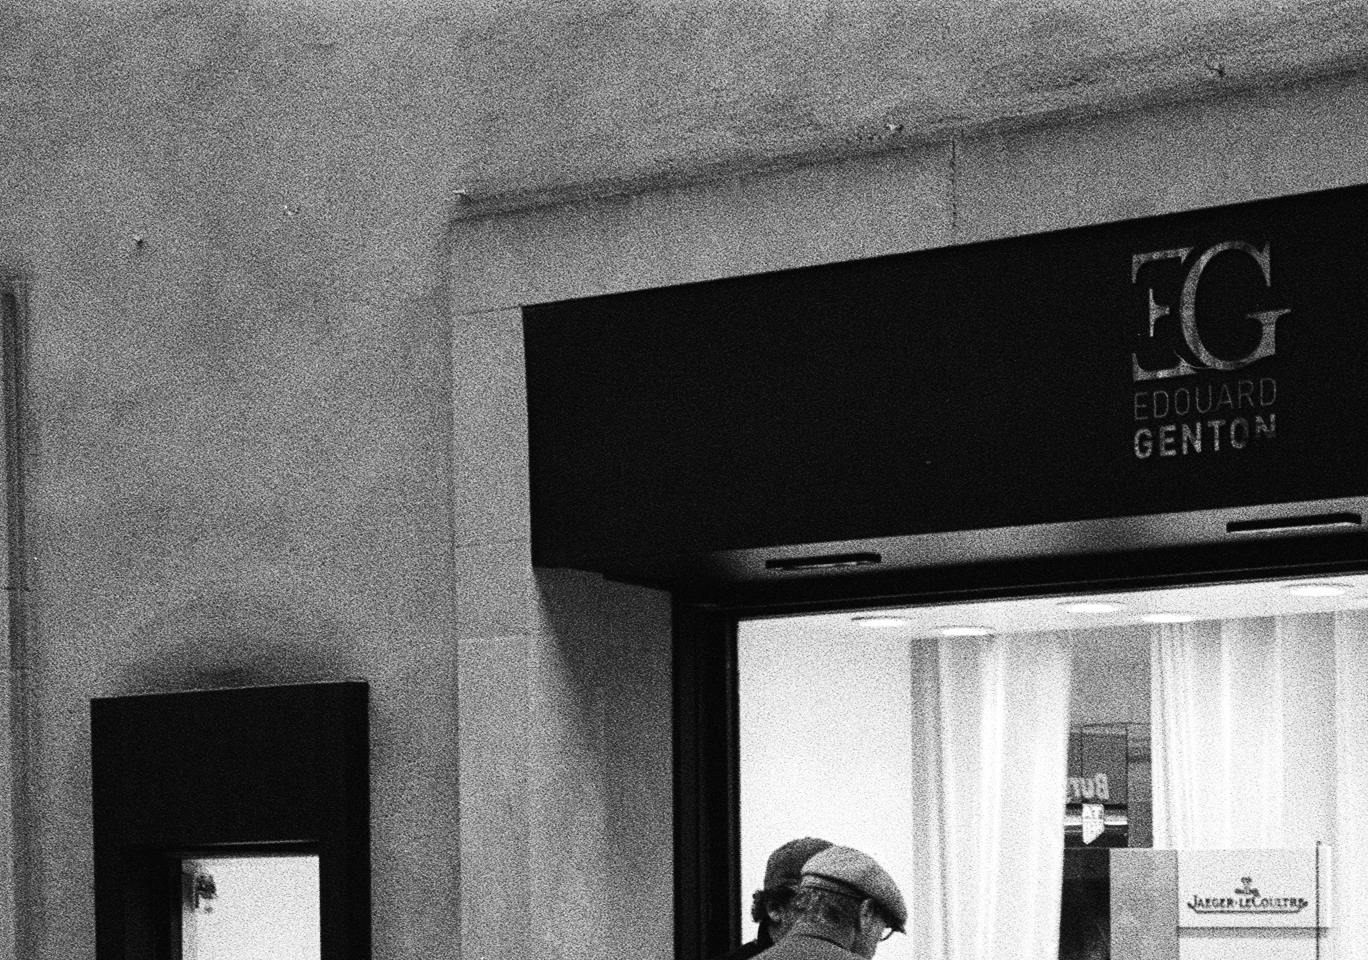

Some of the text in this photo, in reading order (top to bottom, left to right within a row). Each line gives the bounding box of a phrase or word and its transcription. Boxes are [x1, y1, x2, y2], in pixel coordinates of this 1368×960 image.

[1131, 240, 1292, 383] EG
[1133, 377, 1278, 422] EDOUARD
[1133, 413, 1277, 460] GENTON
